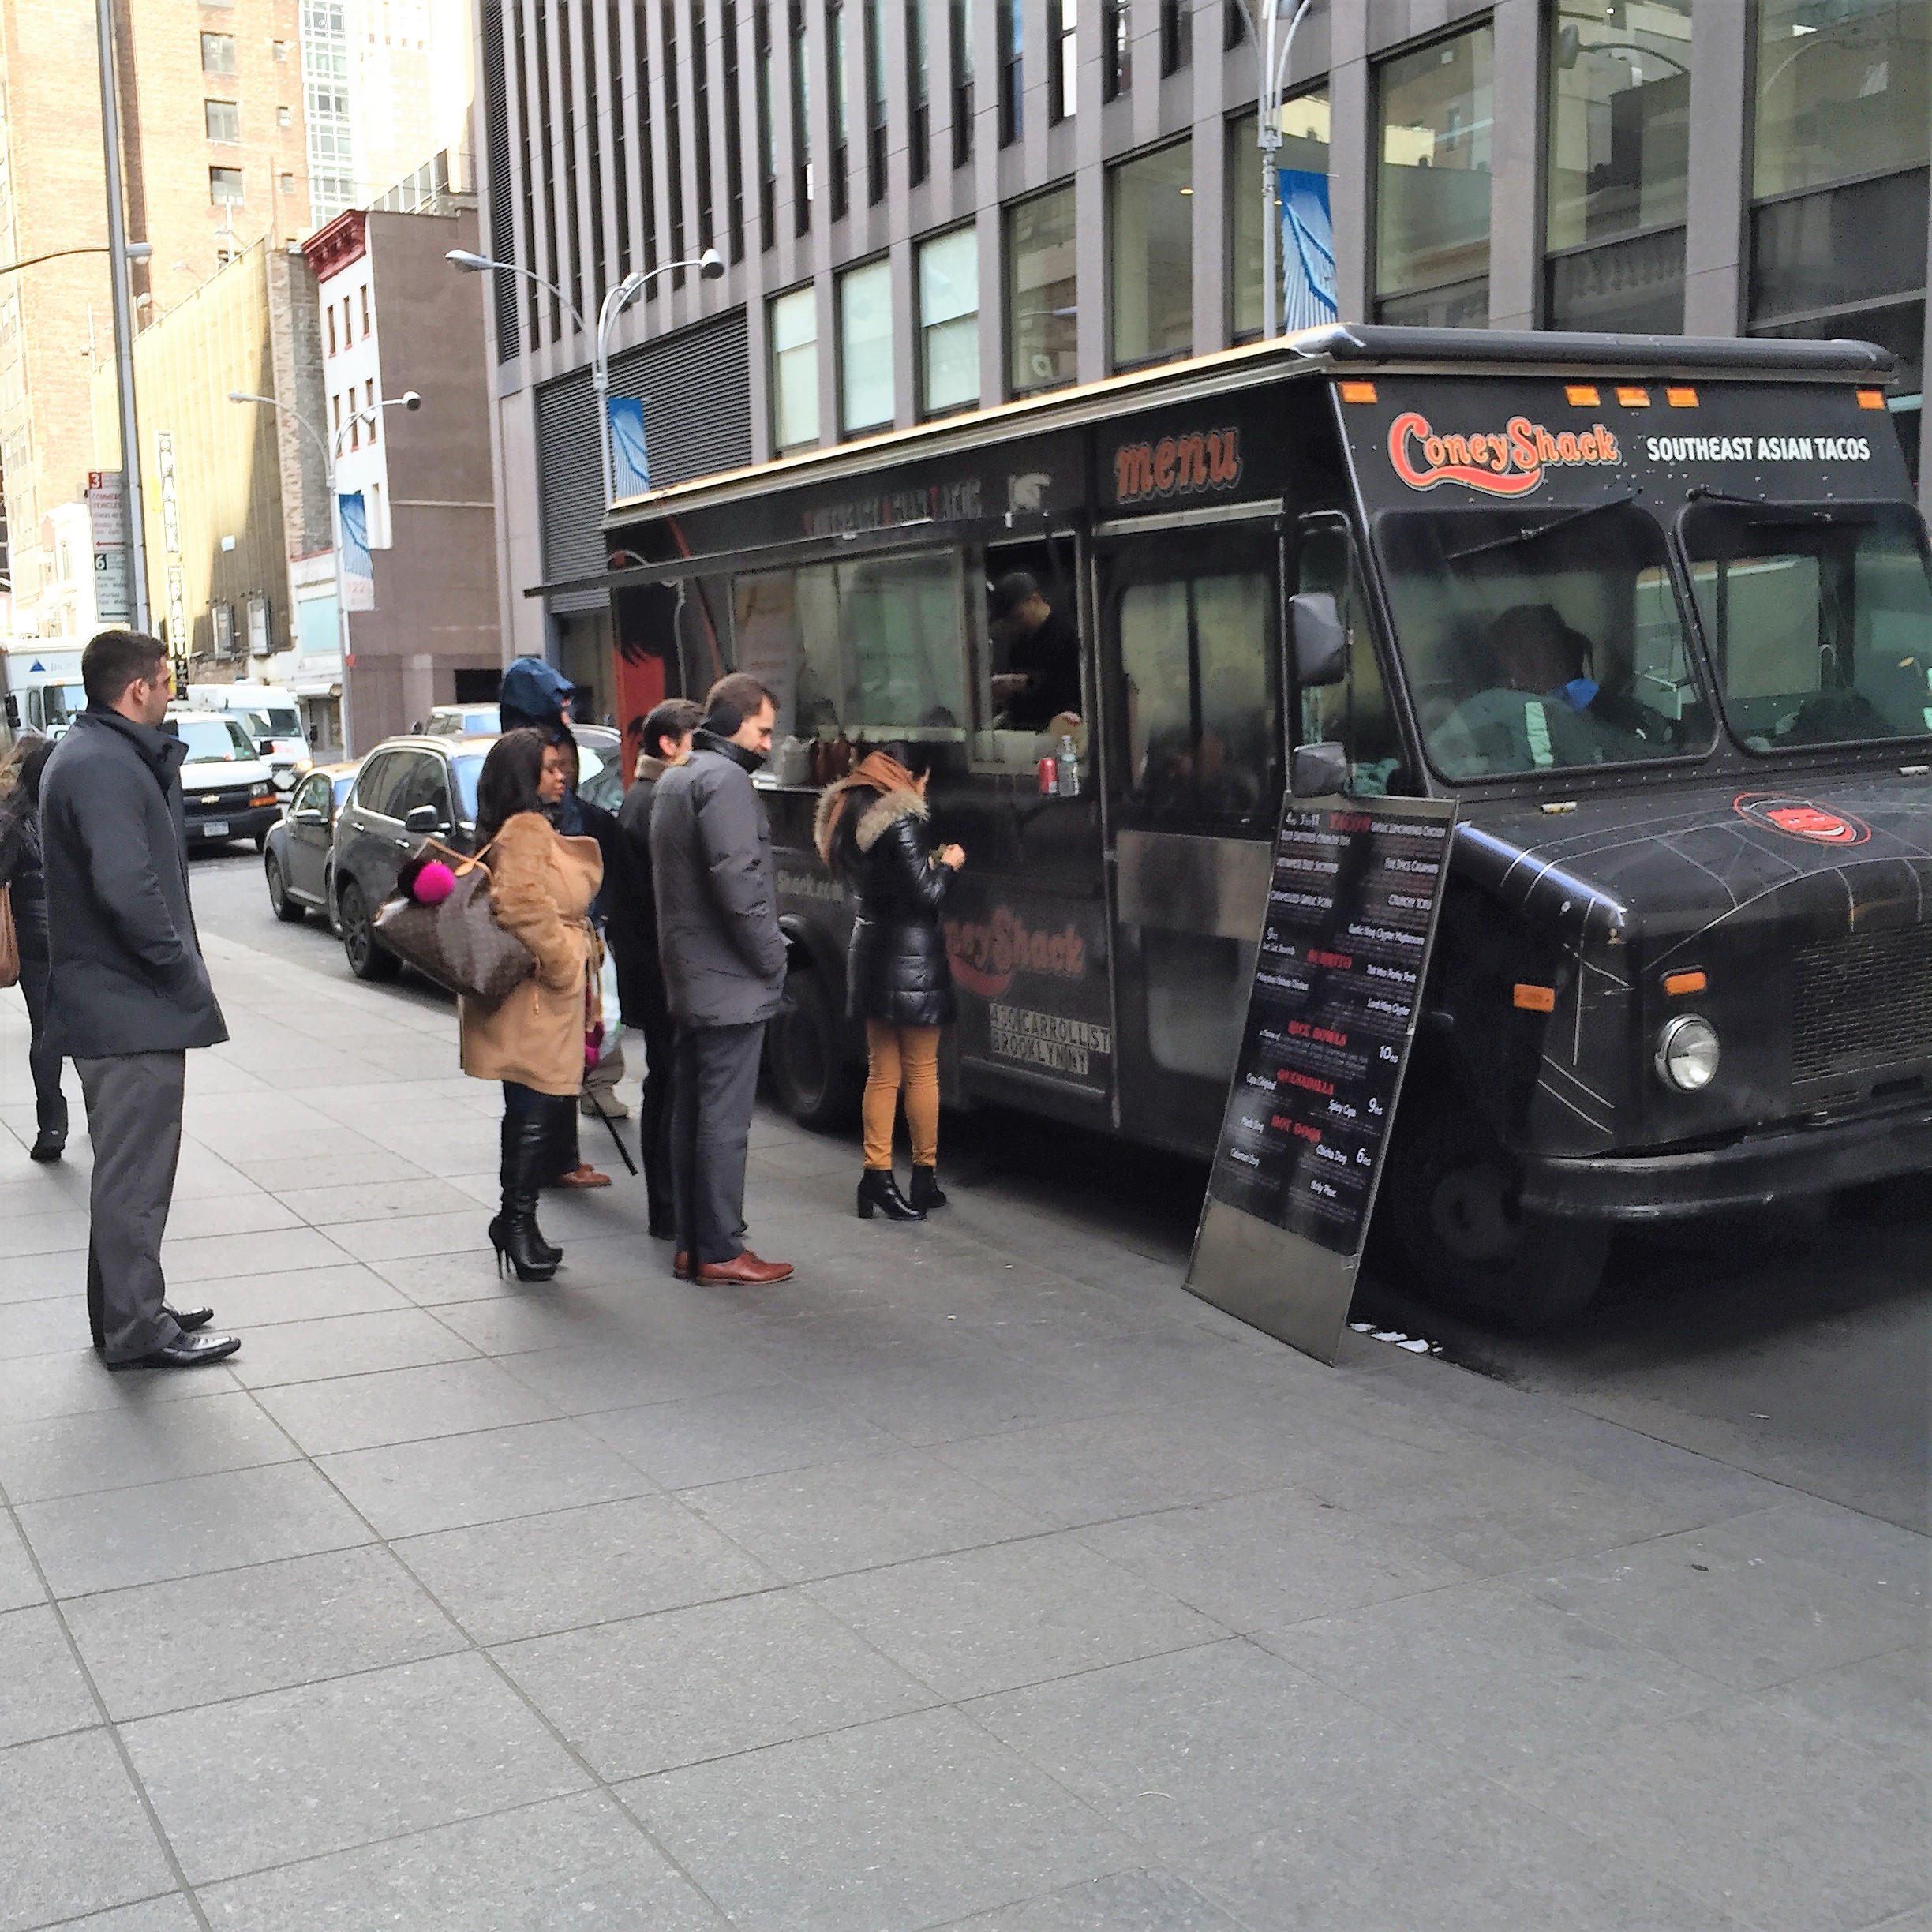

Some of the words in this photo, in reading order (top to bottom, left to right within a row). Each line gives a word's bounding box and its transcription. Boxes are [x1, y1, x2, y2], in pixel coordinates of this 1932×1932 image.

[1114, 426, 1241, 504] menu
[1646, 436, 1754, 461] SOUTHEAST
[1758, 436, 1814, 461] ASIAN
[1814, 436, 1870, 461] TACOS
